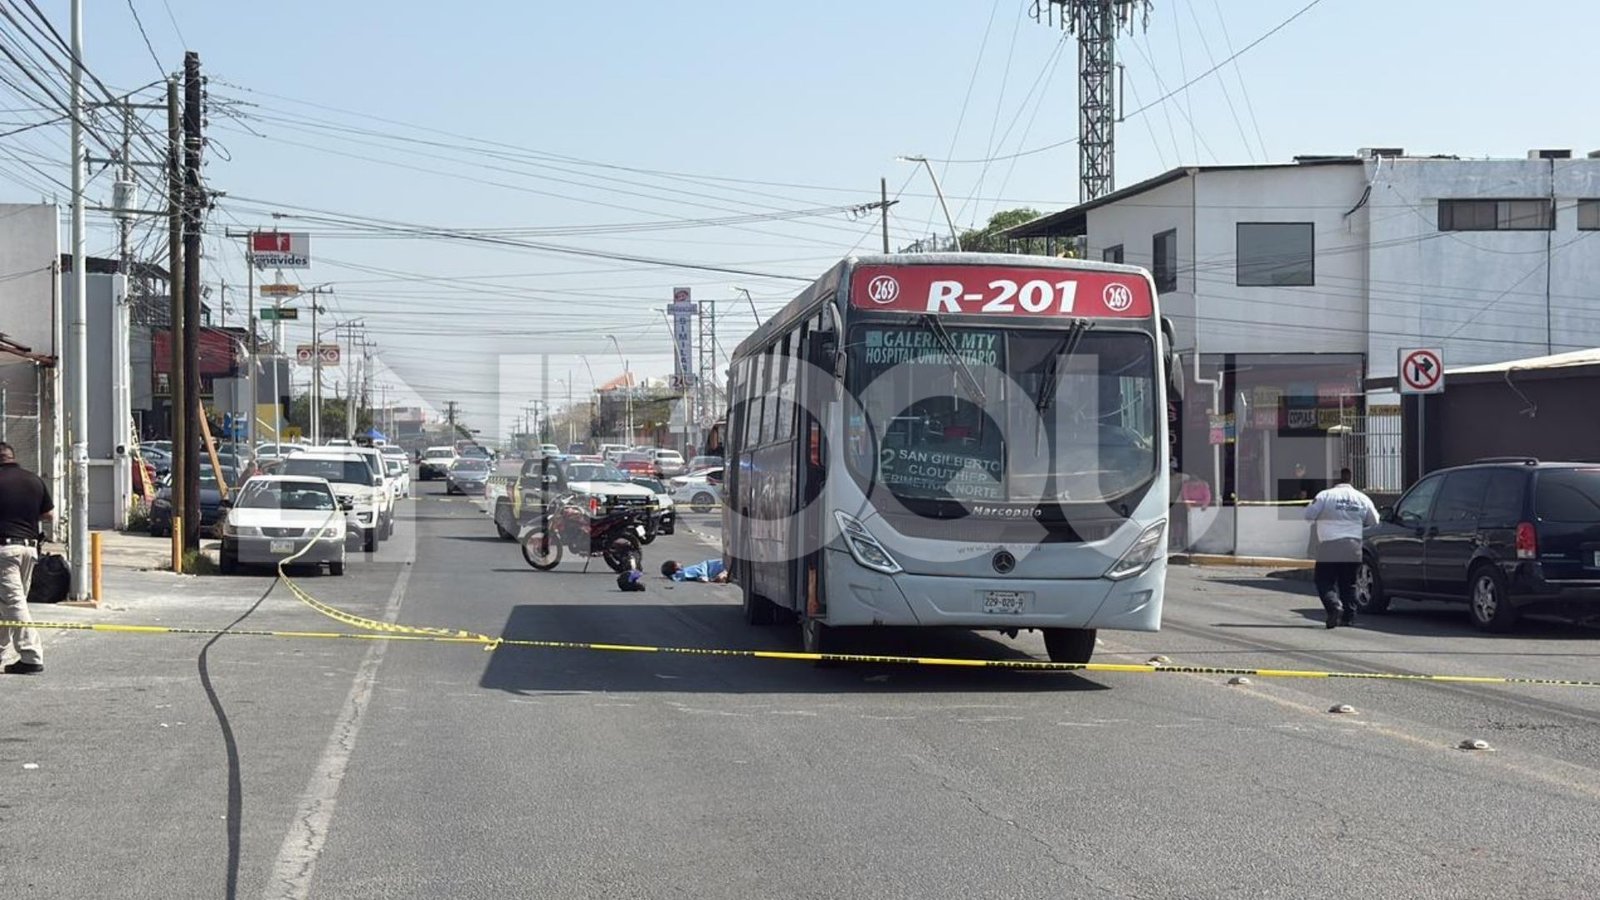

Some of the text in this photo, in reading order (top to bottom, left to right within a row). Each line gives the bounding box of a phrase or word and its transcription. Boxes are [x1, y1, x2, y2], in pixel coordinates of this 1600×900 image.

[874, 280, 896, 300] 269
[926, 279, 1077, 314] R-201
[1109, 287, 1128, 307] 269
[961, 333, 997, 349] MTY
[865, 348, 915, 364] HOSPITAL
[898, 449, 1001, 472] SAN GILBERTO
[908, 463, 988, 482] CLOUTHIER
[955, 484, 999, 498] NORTE
[972, 505, 1042, 517] Marcopolo
